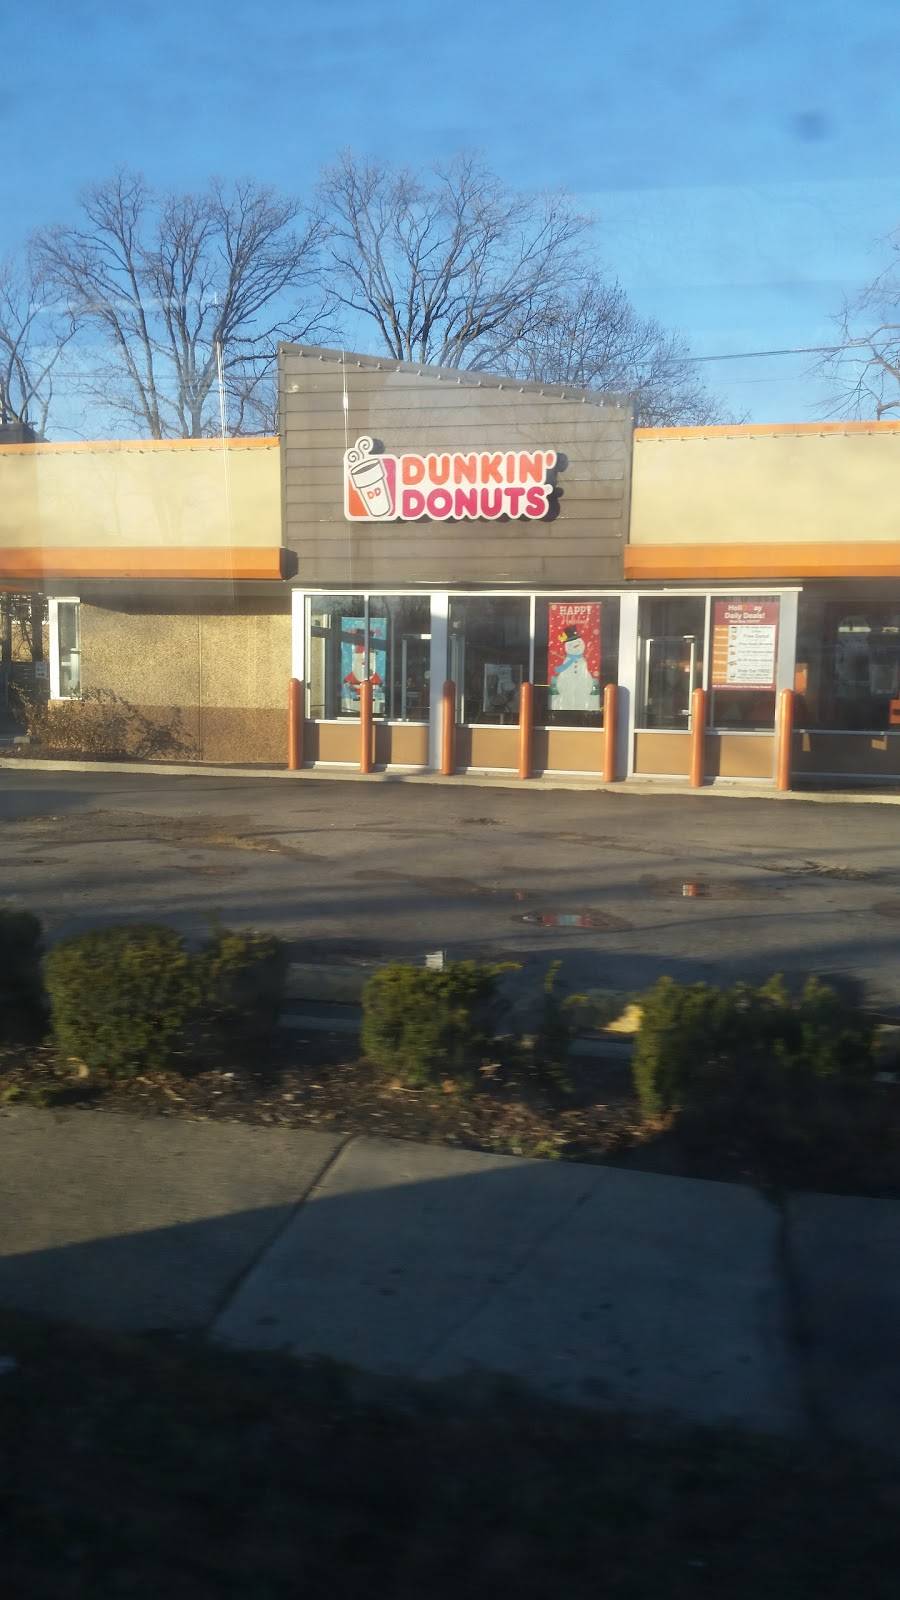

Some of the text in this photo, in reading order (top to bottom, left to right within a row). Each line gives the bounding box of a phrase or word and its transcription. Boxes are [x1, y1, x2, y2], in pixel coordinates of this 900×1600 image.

[401, 452, 555, 486] DUNKIN'
[367, 487, 382, 500] DD
[401, 486, 546, 518] DONUTS
[559, 605, 592, 615] HAPPY
[724, 612, 742, 620] Daily
